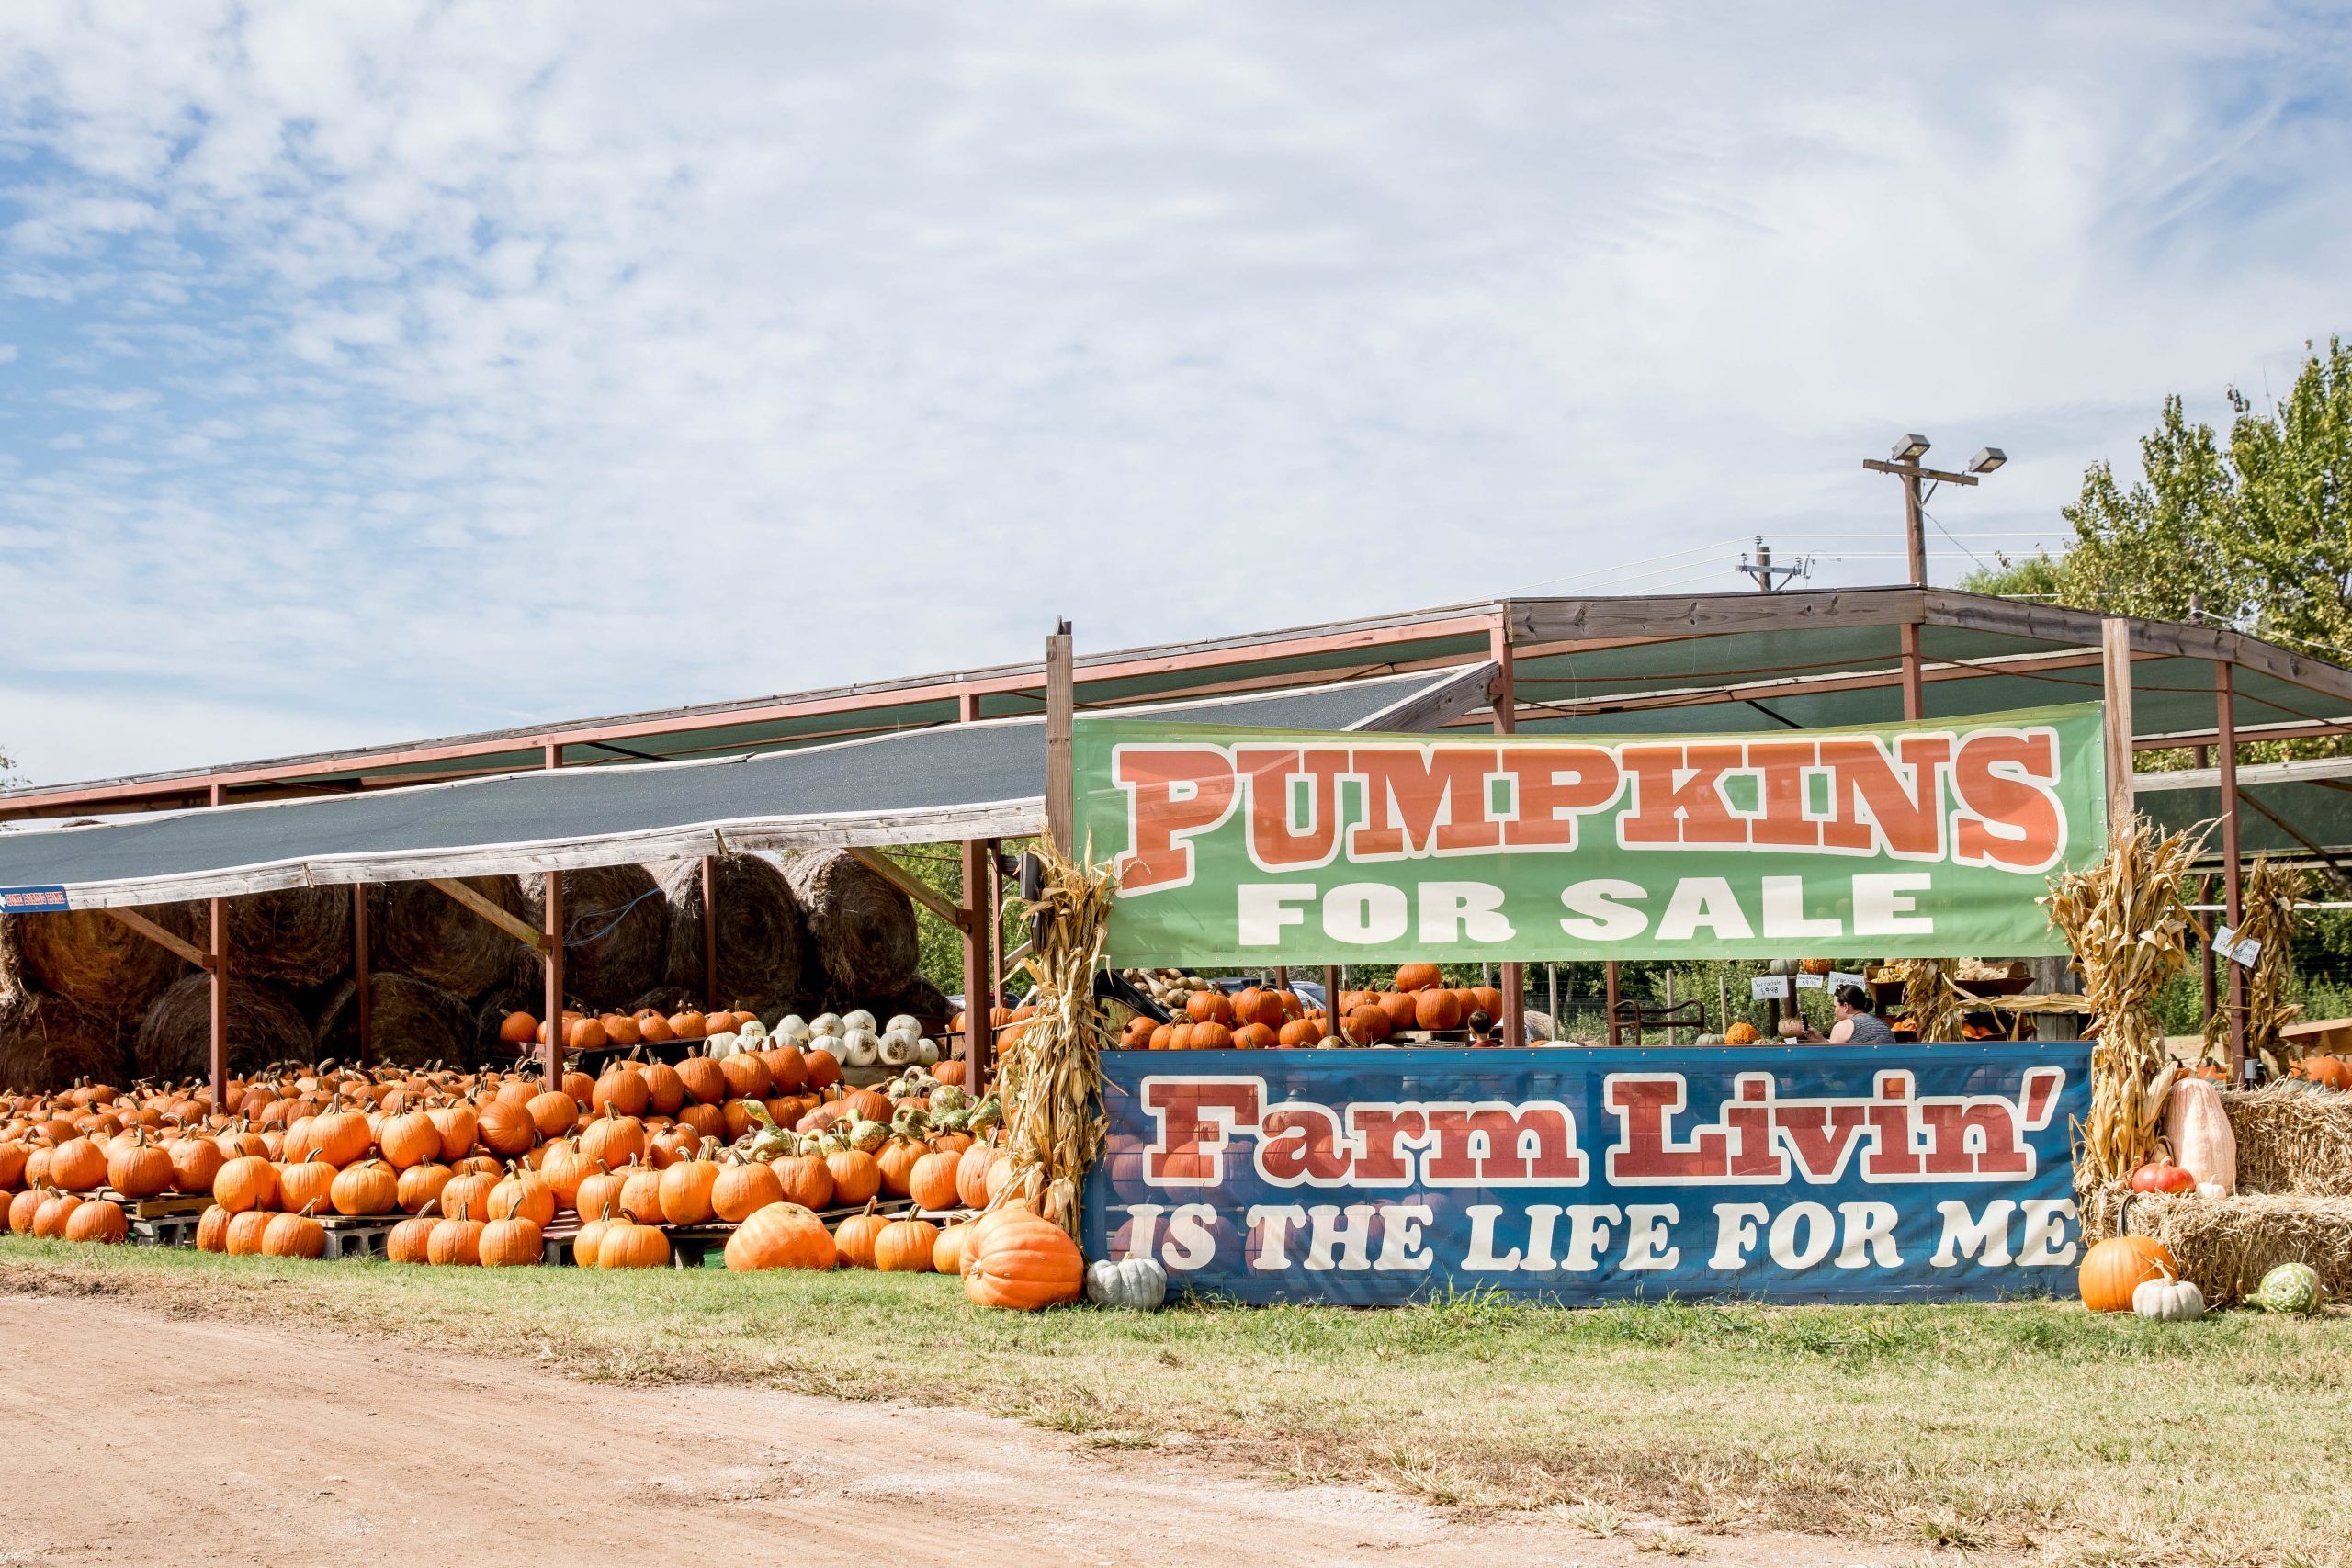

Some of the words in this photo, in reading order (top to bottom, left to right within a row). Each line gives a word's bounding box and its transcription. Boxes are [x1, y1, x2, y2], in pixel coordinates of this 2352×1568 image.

[1112, 727, 2068, 897] PUMPKINS
[5, 894, 24, 906] HOME
[45, 892, 65, 904] HOME
[1238, 882, 1516, 946] FOR
[1560, 872, 1934, 941] SALE
[1141, 1075, 1589, 1187] Farm
[1605, 1066, 2065, 1185] Livin'
[1126, 1203, 1218, 1271] IS
[1246, 1203, 1434, 1271] THE
[1461, 1203, 1680, 1271] LIFE
[1708, 1201, 1904, 1270] FOR
[1930, 1198, 2077, 1269] ME
